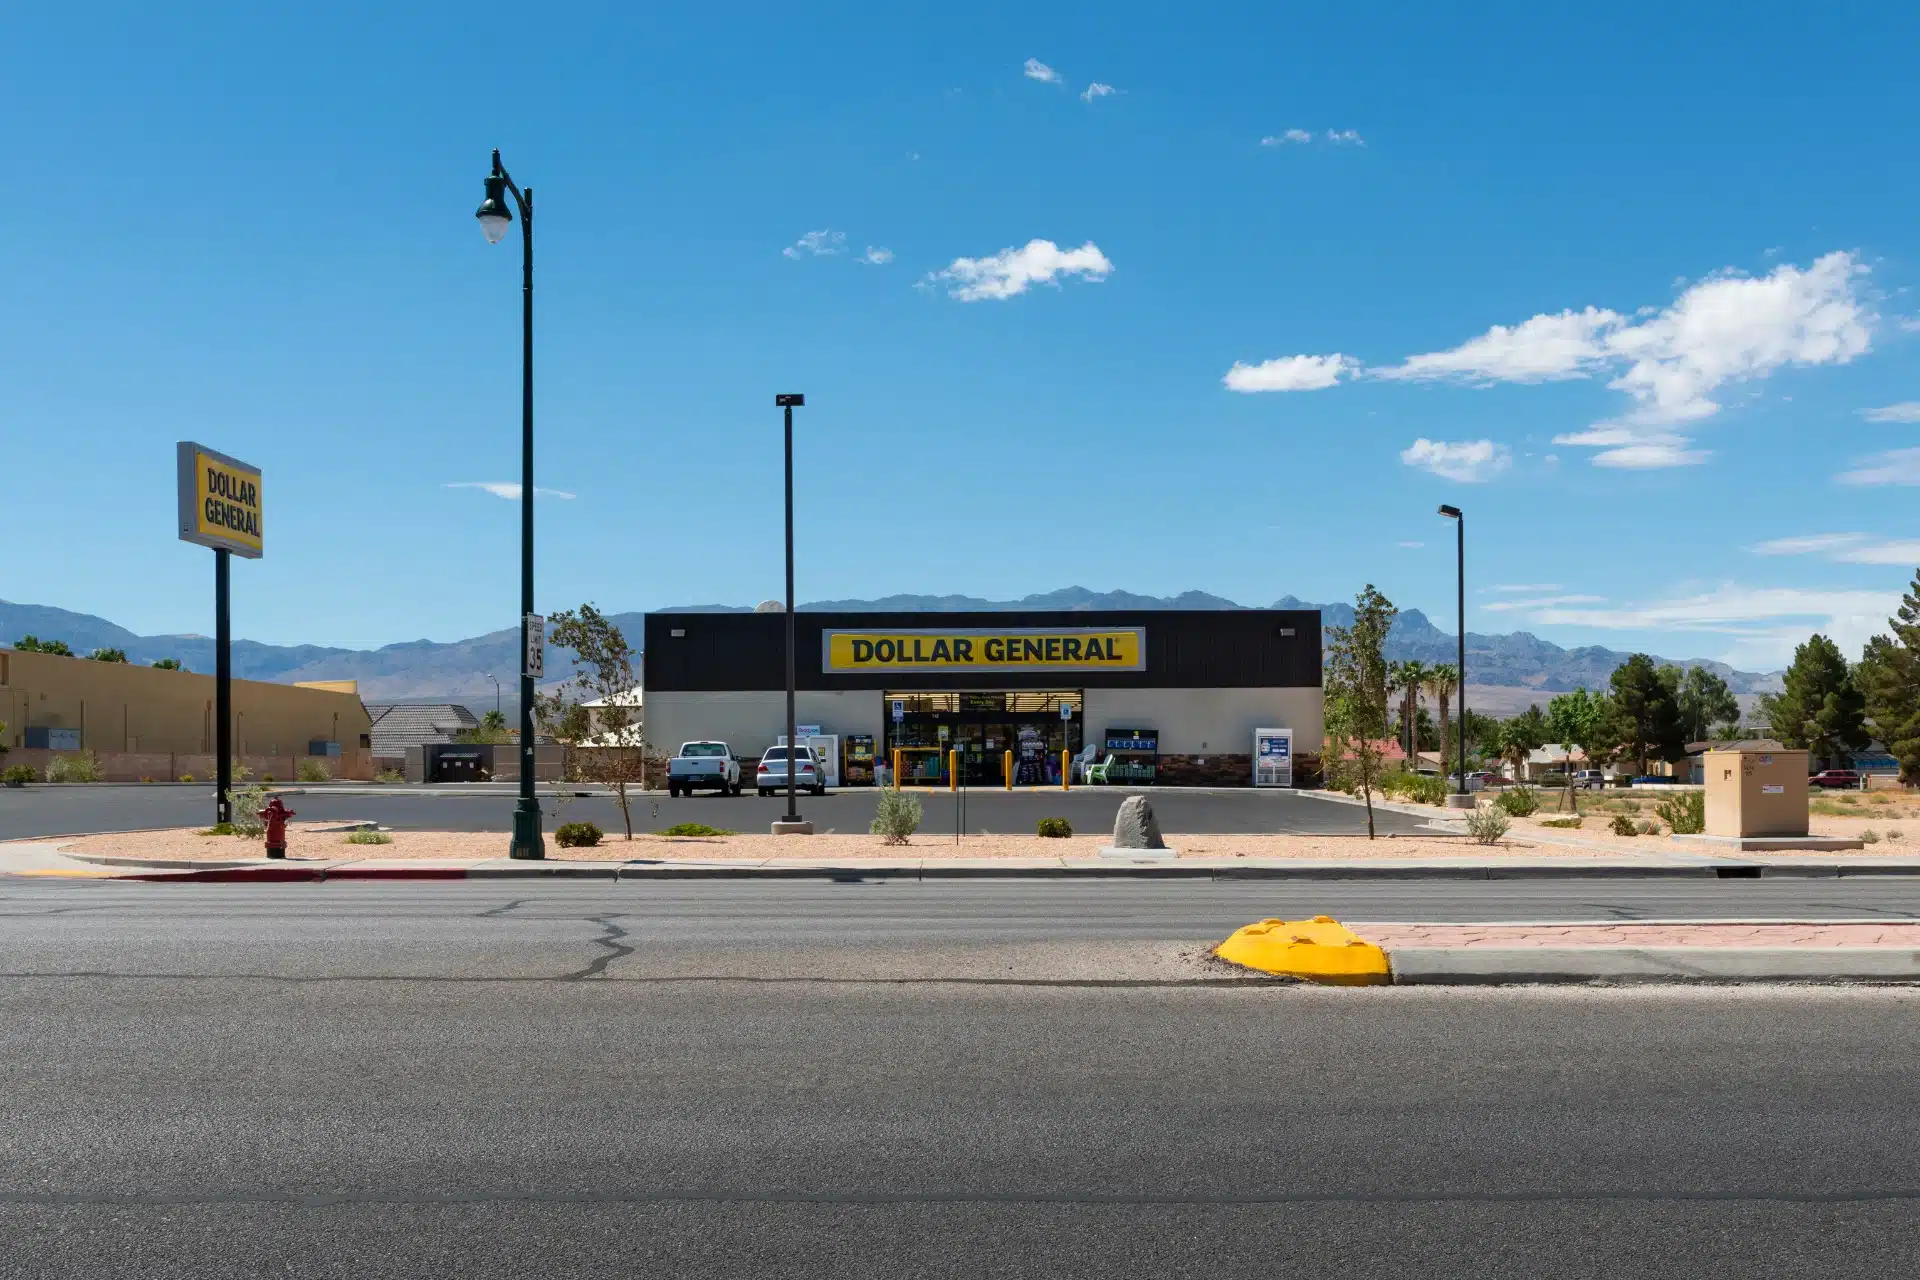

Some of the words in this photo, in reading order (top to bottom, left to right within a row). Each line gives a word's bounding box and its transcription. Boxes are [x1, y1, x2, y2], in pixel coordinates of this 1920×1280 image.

[207, 467, 256, 509] DOLLAR
[205, 497, 261, 538] GENERAL
[529, 646, 542, 671] 35
[851, 638, 974, 662] DOLLAR
[984, 636, 1122, 661] GENERAL
